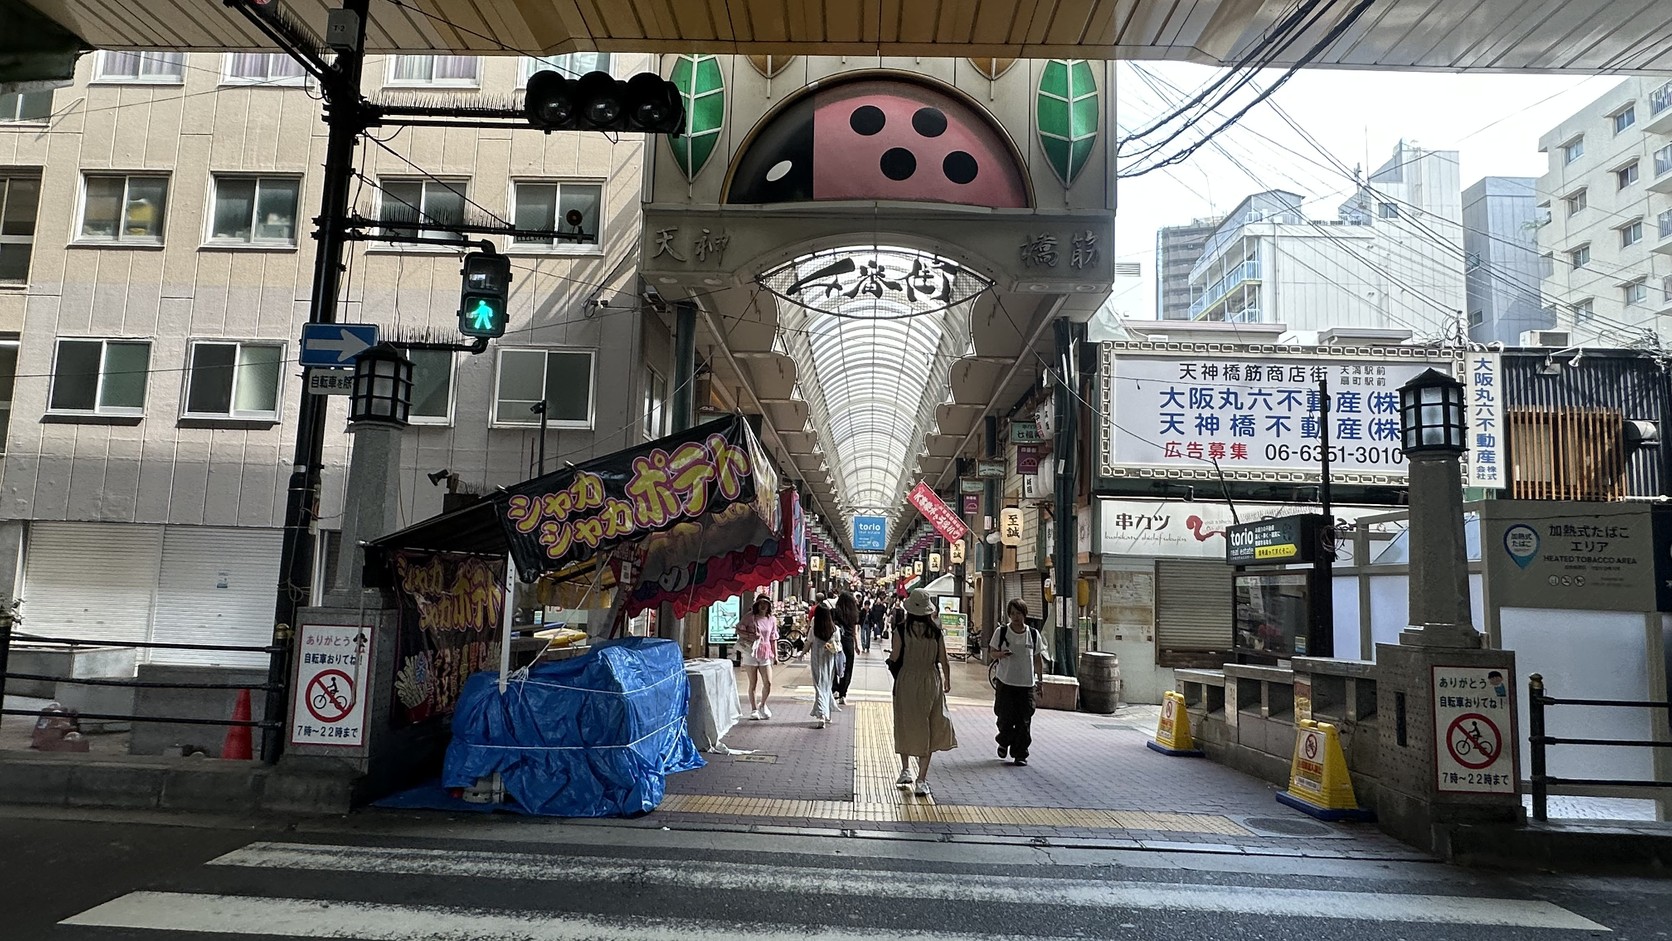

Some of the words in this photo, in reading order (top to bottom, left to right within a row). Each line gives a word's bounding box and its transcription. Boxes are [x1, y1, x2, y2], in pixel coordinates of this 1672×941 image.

[651, 227, 732, 268] 天神
[1021, 230, 1100, 269] 橋筋
[786, 257, 963, 303] 一番街
[1179, 363, 1328, 383] 天神橋筋商店街
[1340, 365, 1386, 375] 天満駅前
[1340, 376, 1386, 387] 扇町駅前
[1473, 357, 1496, 464] 大阪丸六不動産
[1164, 441, 1249, 460] 広告募集
[1265, 443, 1404, 465] 06-6351-3010
[627, 432, 752, 528] ポテト
[859, 523, 881, 531] torio
[1115, 513, 1171, 532] 串カツ
[1230, 528, 1254, 546] torio
[1549, 524, 1630, 539] 加熱式たばこ
[1571, 541, 1609, 553] エリア
[1543, 555, 1574, 563] HEATED
[1575, 556, 1615, 564] TOBACCO
[1615, 557, 1638, 565] AREA
[306, 635, 351, 647] ありがとう
[1439, 677, 1487, 689] ありがとう
[1440, 696, 1504, 710] 自転車おりてね！
